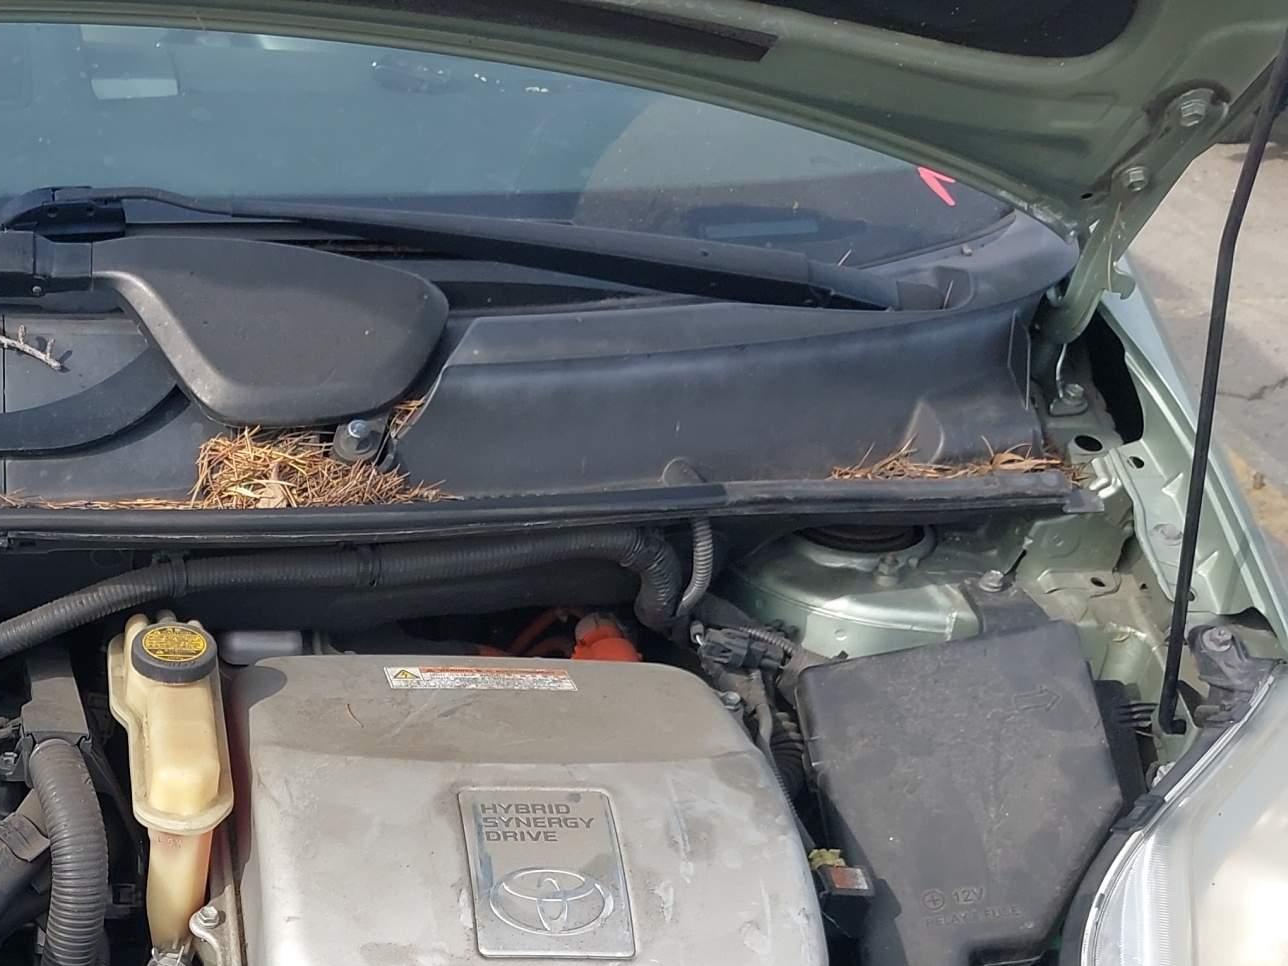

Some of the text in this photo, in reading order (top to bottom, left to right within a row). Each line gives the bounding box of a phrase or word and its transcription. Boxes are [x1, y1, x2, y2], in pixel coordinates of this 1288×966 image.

[481, 803, 571, 815] HYBRID
[483, 817, 595, 829] SYNERGY
[485, 830, 559, 842] DRIVE
[952, 887, 985, 904] 12V
